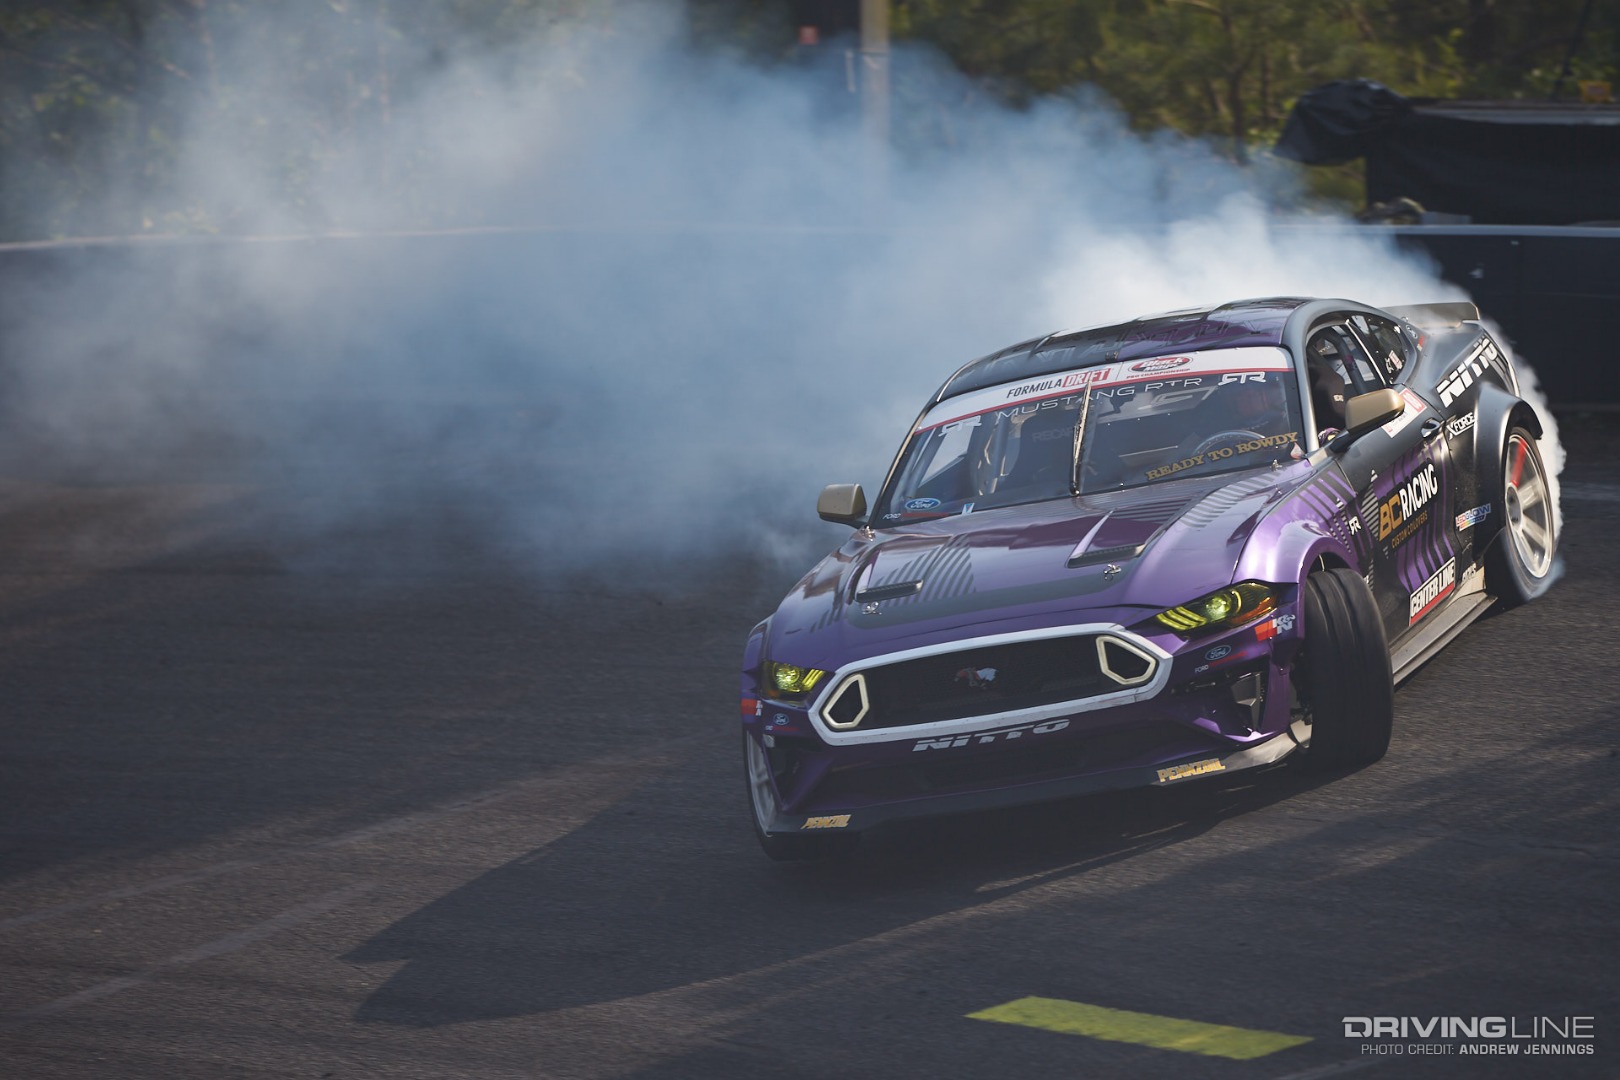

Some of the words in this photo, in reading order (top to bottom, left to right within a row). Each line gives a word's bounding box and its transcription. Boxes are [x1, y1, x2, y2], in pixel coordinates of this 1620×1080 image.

[1006, 380, 1063, 398] FORMULA
[1064, 368, 1109, 388] DRIFT
[1436, 338, 1498, 409] NITTO
[996, 386, 1135, 424] MUSTANG
[1145, 377, 1202, 392] RTR
[1145, 454, 1205, 481] READY
[1207, 447, 1233, 462] TO
[1235, 431, 1299, 454] ROWDY
[1399, 463, 1438, 521] RACING
[1411, 574, 1439, 617] CENTER
[1438, 560, 1455, 589] LINE
[1195, 664, 1209, 673] FORD
[1207, 646, 1230, 660] Ford
[912, 719, 1070, 752] NITTO
[1157, 758, 1226, 783] PENNZOIL
